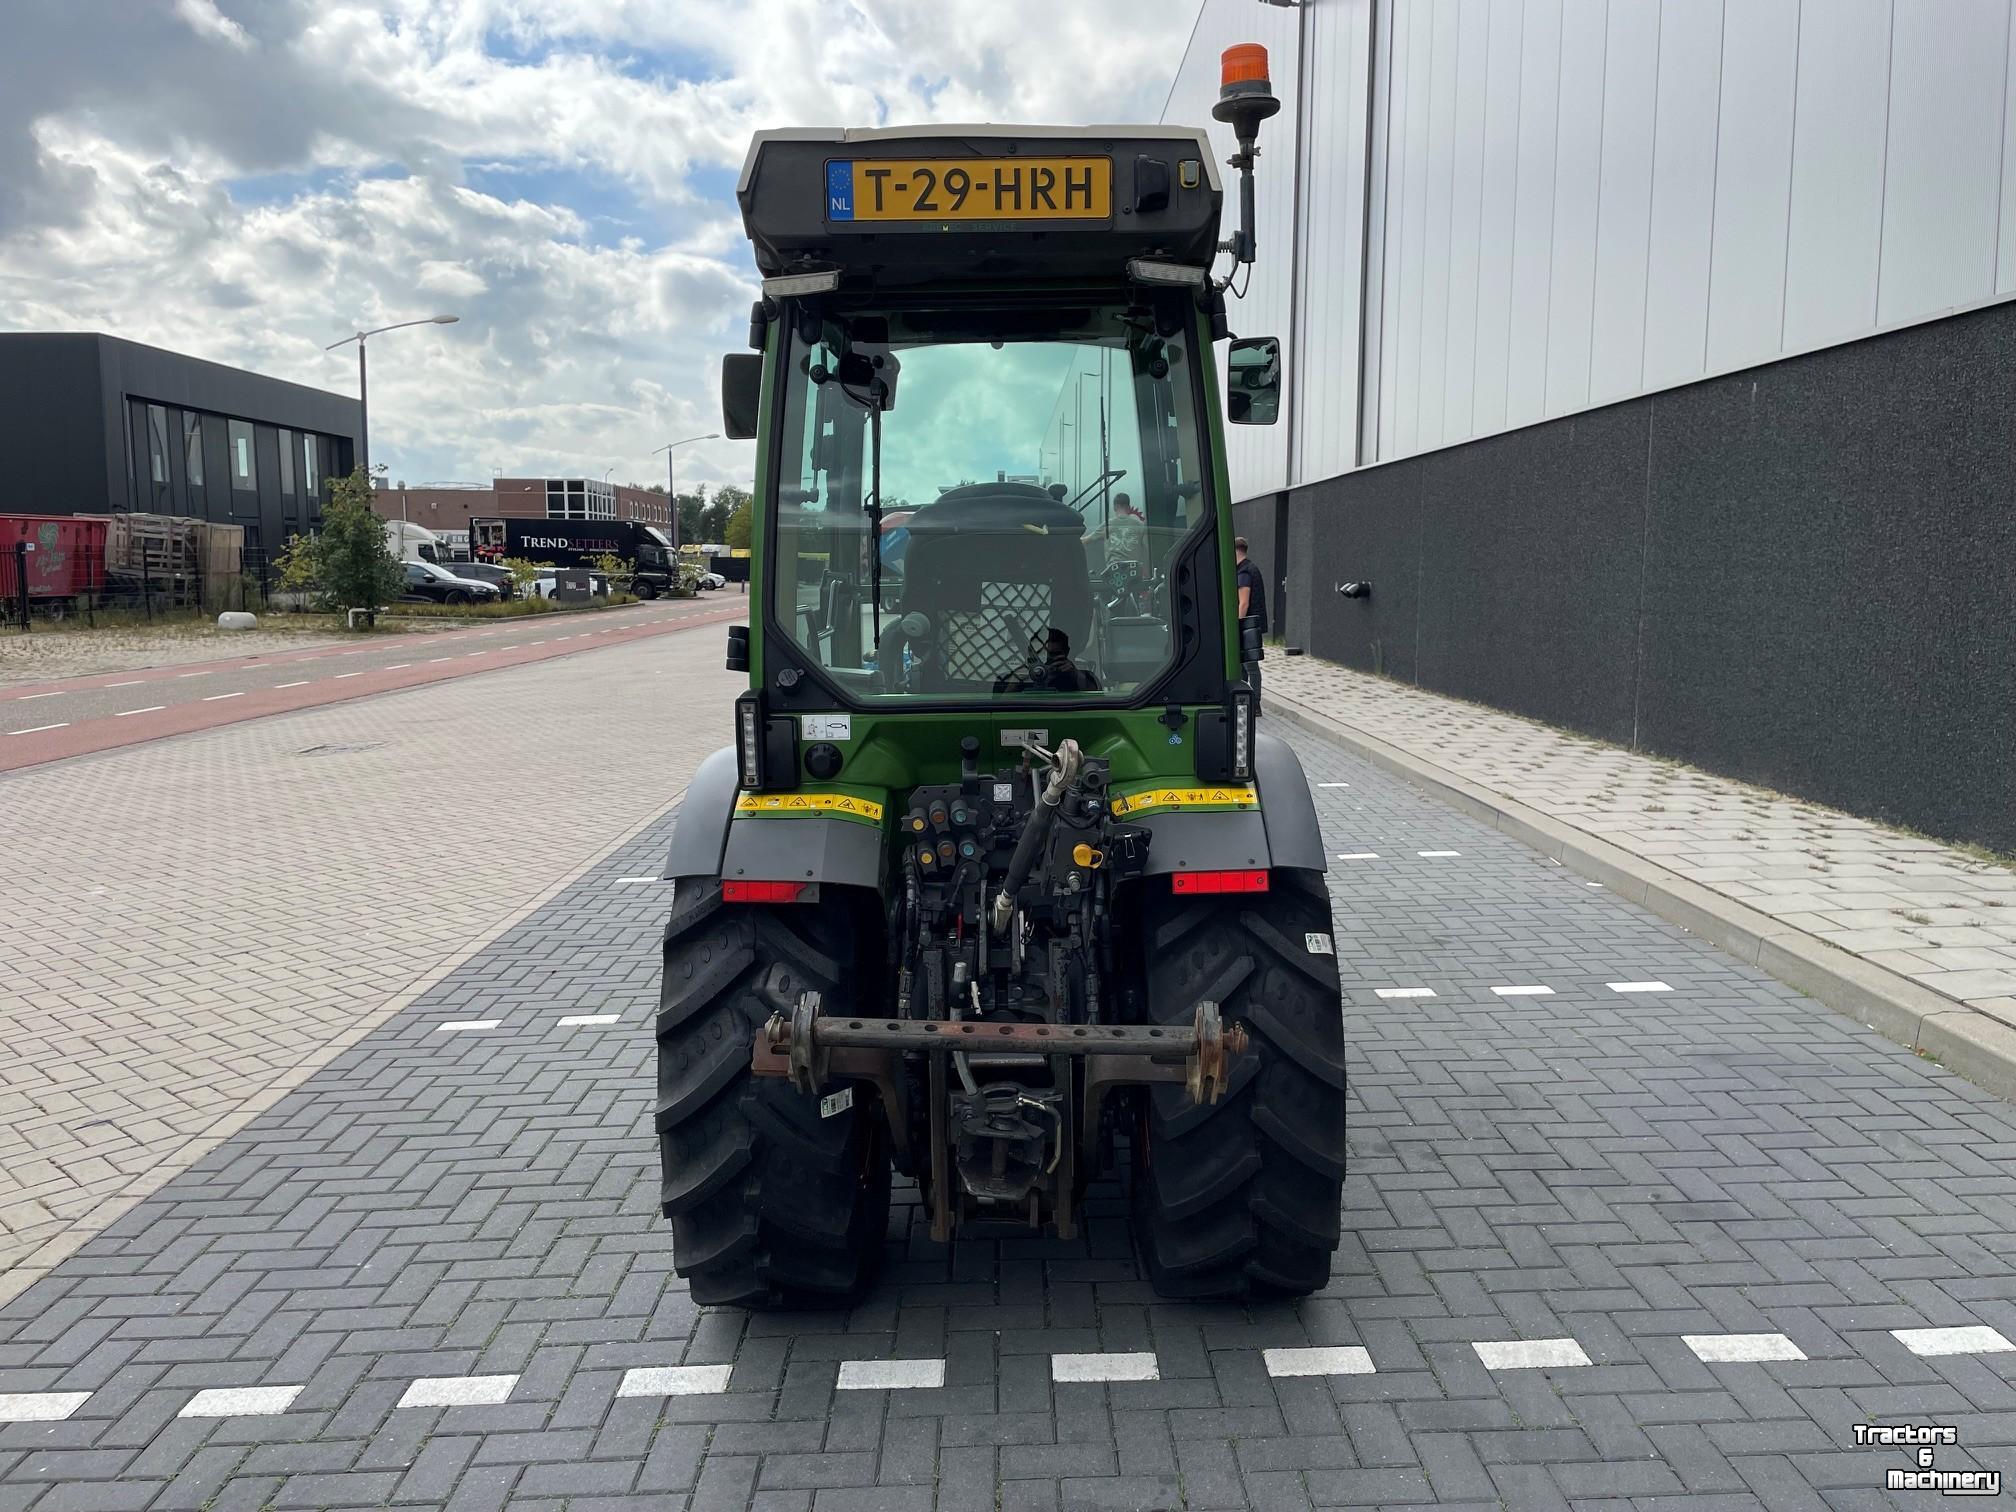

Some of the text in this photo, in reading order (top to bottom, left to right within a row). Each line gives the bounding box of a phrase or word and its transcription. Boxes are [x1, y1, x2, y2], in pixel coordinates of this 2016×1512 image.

[865, 167, 1092, 212] T-29-HRH
[831, 197, 850, 211] NL
[520, 536, 619, 549] TRENDSETTERS
